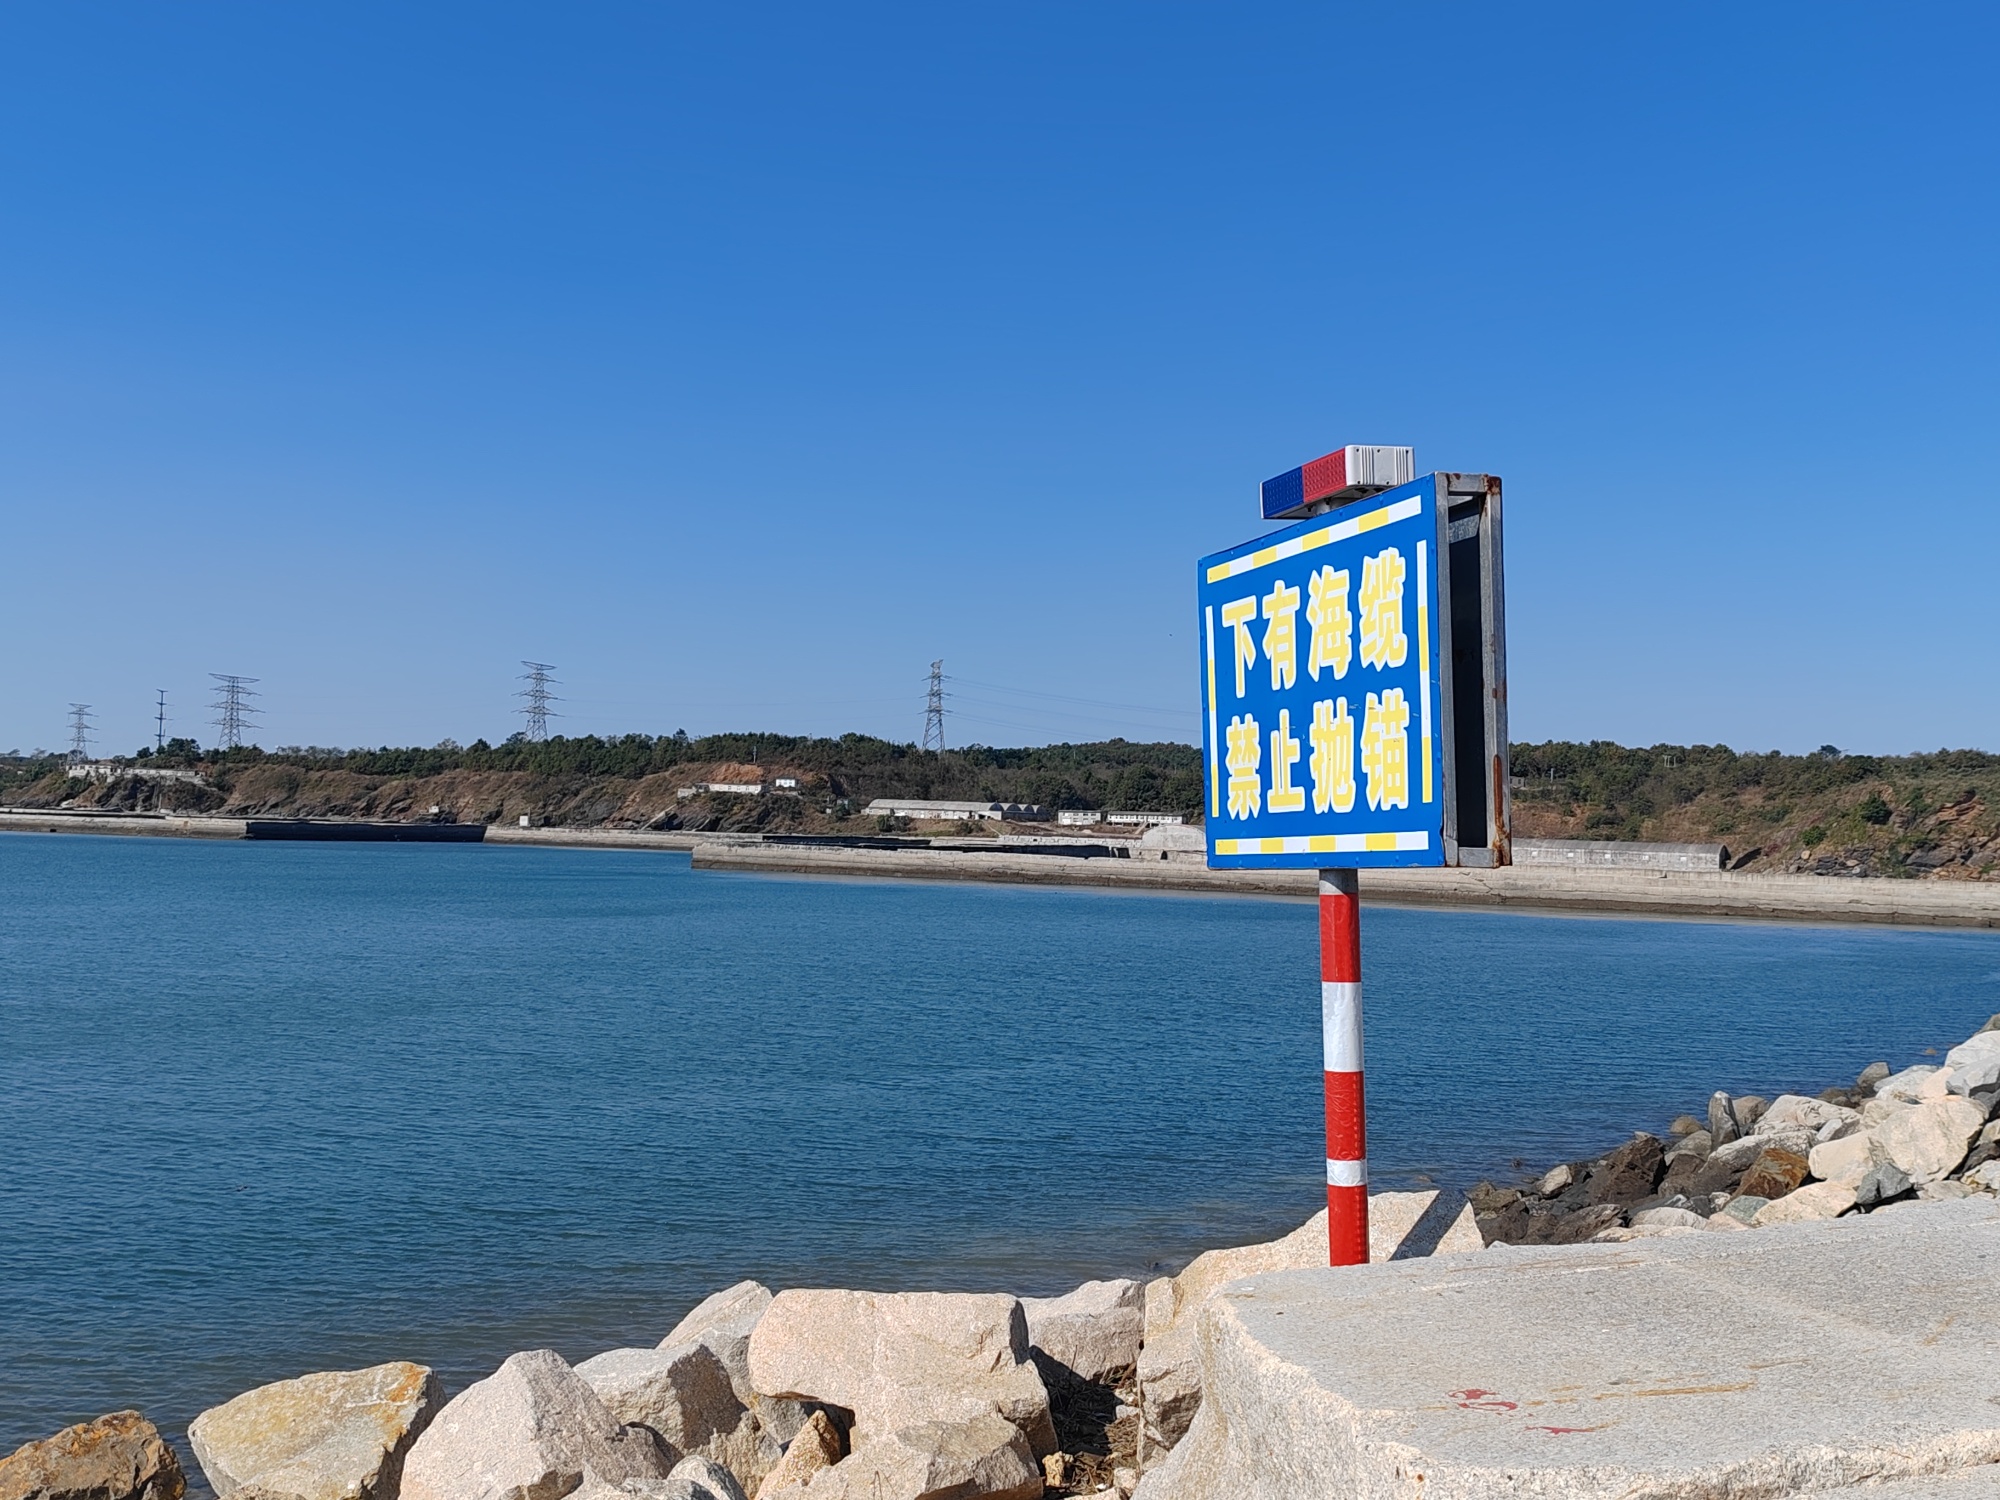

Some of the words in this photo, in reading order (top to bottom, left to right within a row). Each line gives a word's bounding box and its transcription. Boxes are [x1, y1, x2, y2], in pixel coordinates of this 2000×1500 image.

[1222, 547, 1407, 698] 下有海缆
[1226, 688, 1409, 820] 禁止抛锚
